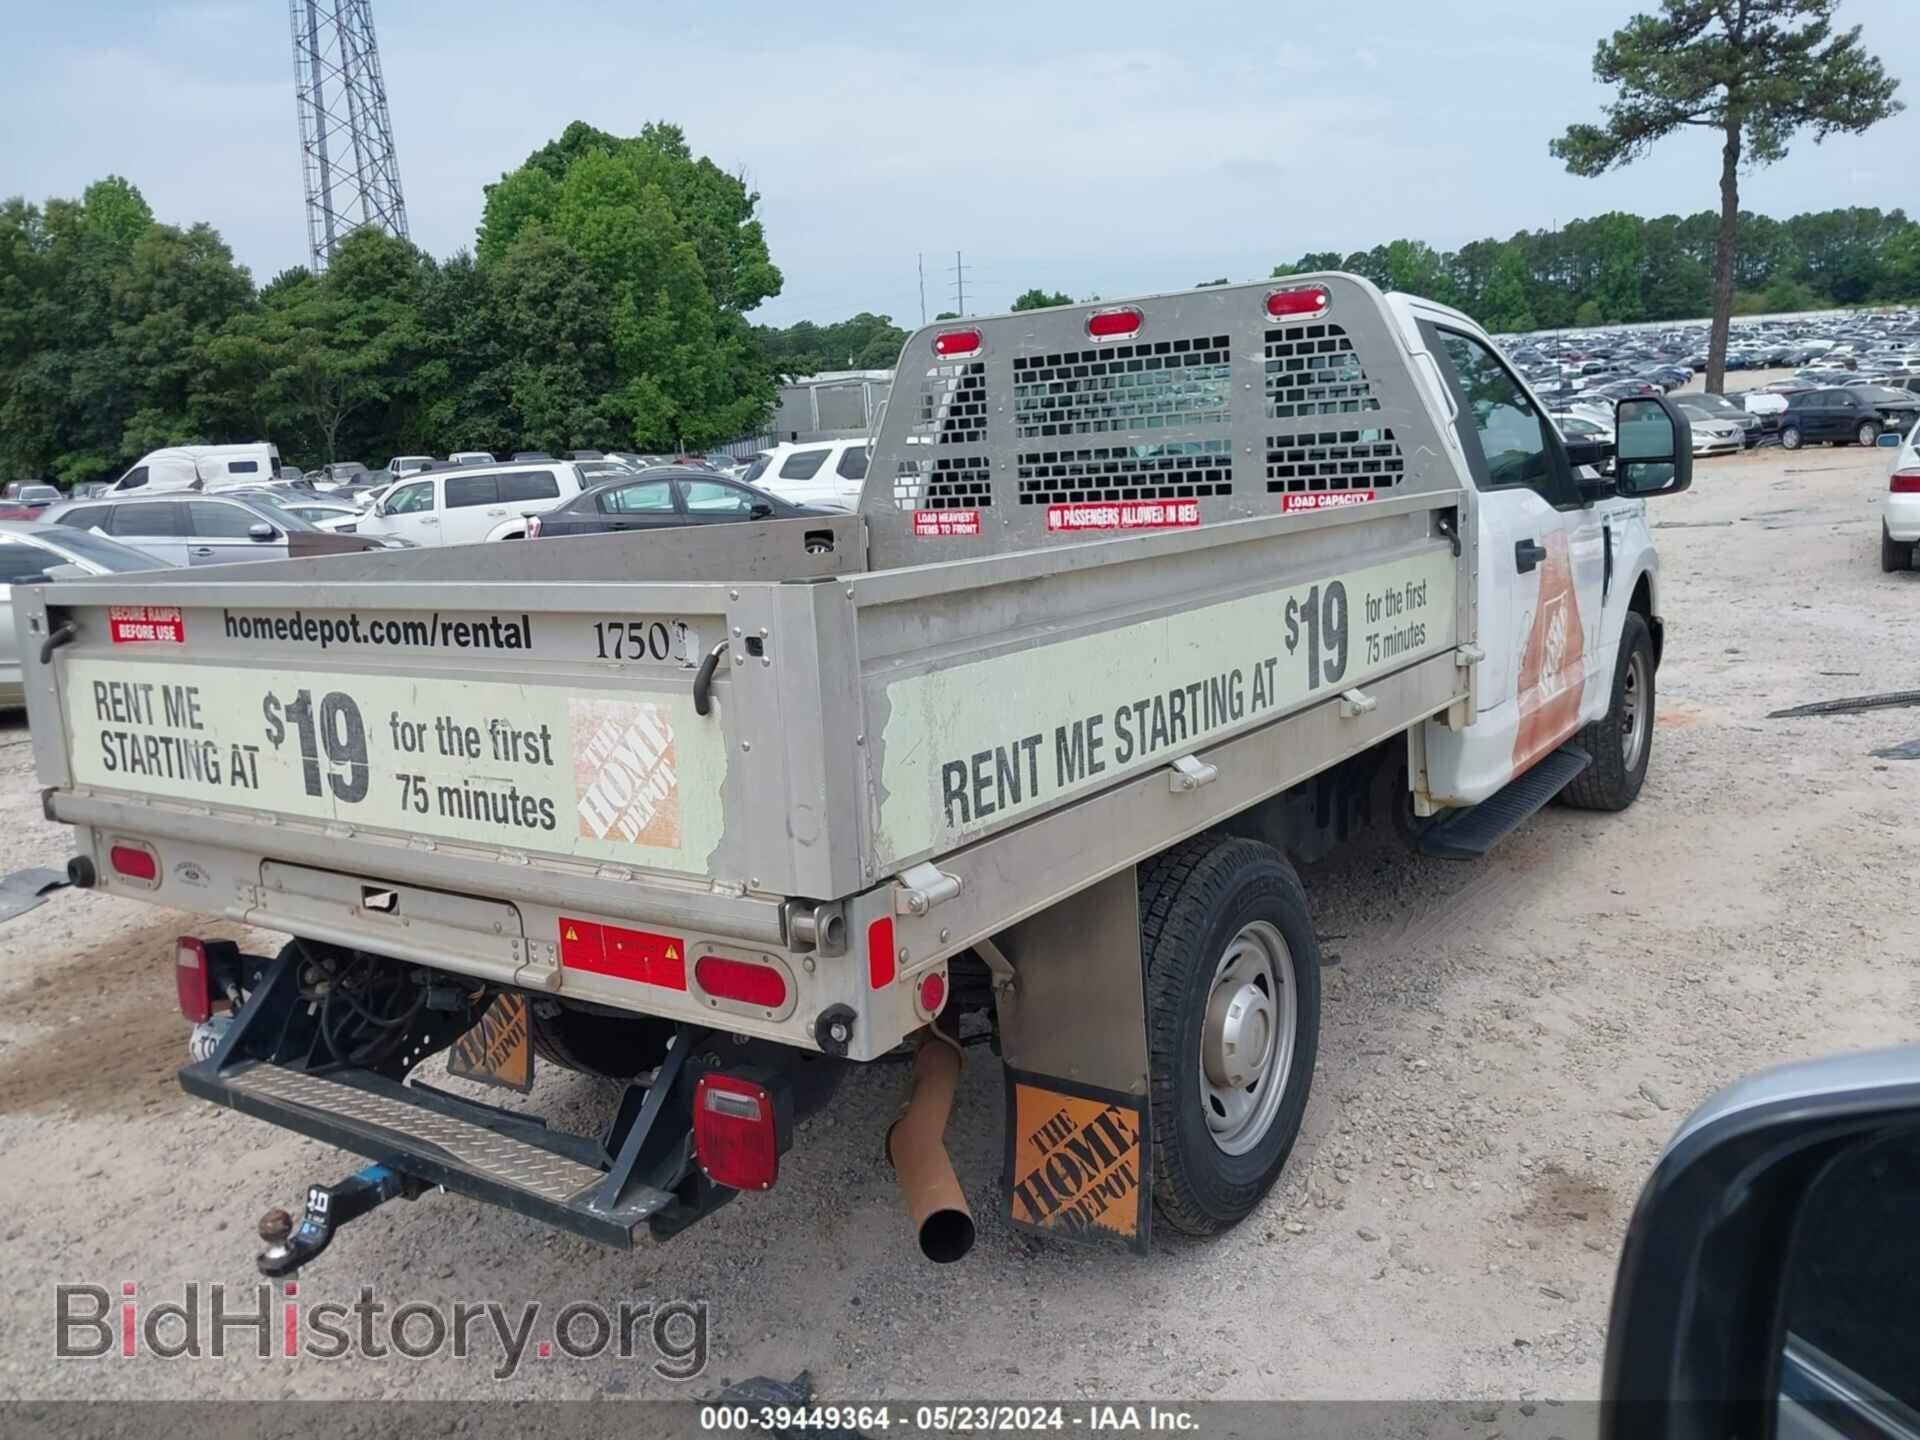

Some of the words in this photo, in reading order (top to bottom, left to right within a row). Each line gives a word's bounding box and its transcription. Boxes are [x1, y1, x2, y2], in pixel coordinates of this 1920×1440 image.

[917, 512, 937, 523] LOAD
[938, 511, 975, 523] HEAVIEST
[1049, 510, 1062, 527] NO
[1064, 507, 1120, 526] PASSENGERS
[1121, 505, 1164, 525] ALLOWED
[1166, 505, 1177, 523] IN
[1178, 504, 1198, 522] BED
[1289, 495, 1316, 508] LOAD
[1318, 493, 1369, 507] CAPACITY
[916, 524, 939, 535] ITEMS
[940, 524, 951, 535] TO
[952, 524, 977, 534] FRONT
[1365, 593, 1383, 624] for
[1385, 587, 1403, 618] the
[1405, 578, 1427, 611] first
[119, 623, 155, 640] BEFORE
[156, 624, 177, 640] USE
[223, 608, 532, 649] homedepot.com/rental
[1285, 580, 1348, 690] $19
[1366, 633, 1380, 665] 75
[1383, 620, 1426, 659] minutes
[93, 680, 154, 725] RENT
[162, 684, 204, 730] ME
[100, 729, 222, 785] STARTING
[230, 743, 260, 789] AT
[263, 688, 370, 803] $19
[389, 711, 427, 753] for
[435, 716, 481, 758] the
[489, 718, 554, 766] first
[942, 734, 1043, 828] RENT
[1055, 713, 1105, 788] ME
[1114, 668, 1244, 765] STARTING
[1251, 657, 1278, 713] AT
[577, 702, 675, 840] HOME
[396, 773, 429, 814] 75
[437, 779, 556, 831] minutes
[1028, 1107, 1078, 1156] THE
[1014, 1104, 1141, 1224] HOME
[1057, 1160, 1139, 1234] DEPOT
